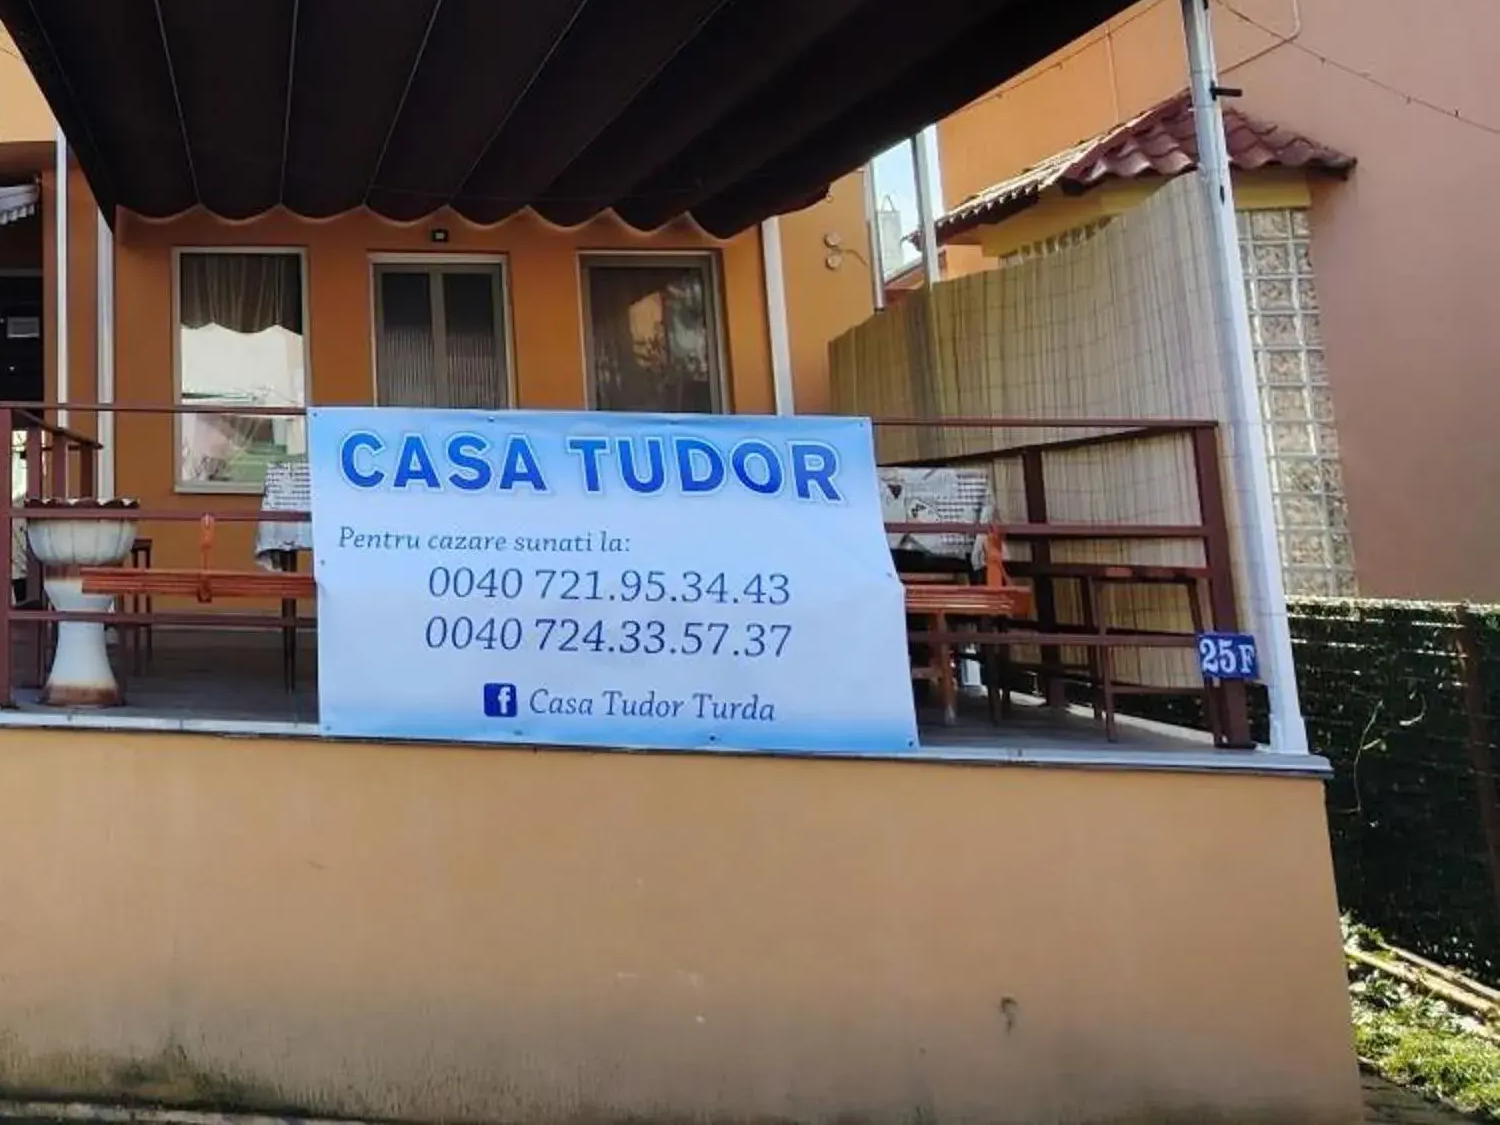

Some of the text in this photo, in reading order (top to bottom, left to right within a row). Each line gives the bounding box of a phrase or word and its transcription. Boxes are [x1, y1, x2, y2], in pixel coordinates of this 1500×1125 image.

[340, 431, 547, 491] CASA
[569, 438, 842, 500] TUDOR
[338, 526, 630, 552] Pentru cazare sunati la:
[429, 566, 790, 605] 0040 721.95.34.43
[426, 616, 792, 658] 0040 724.33.57.37
[529, 688, 593, 715] Casa
[602, 690, 684, 718] Tudor
[693, 692, 775, 721] Turda
